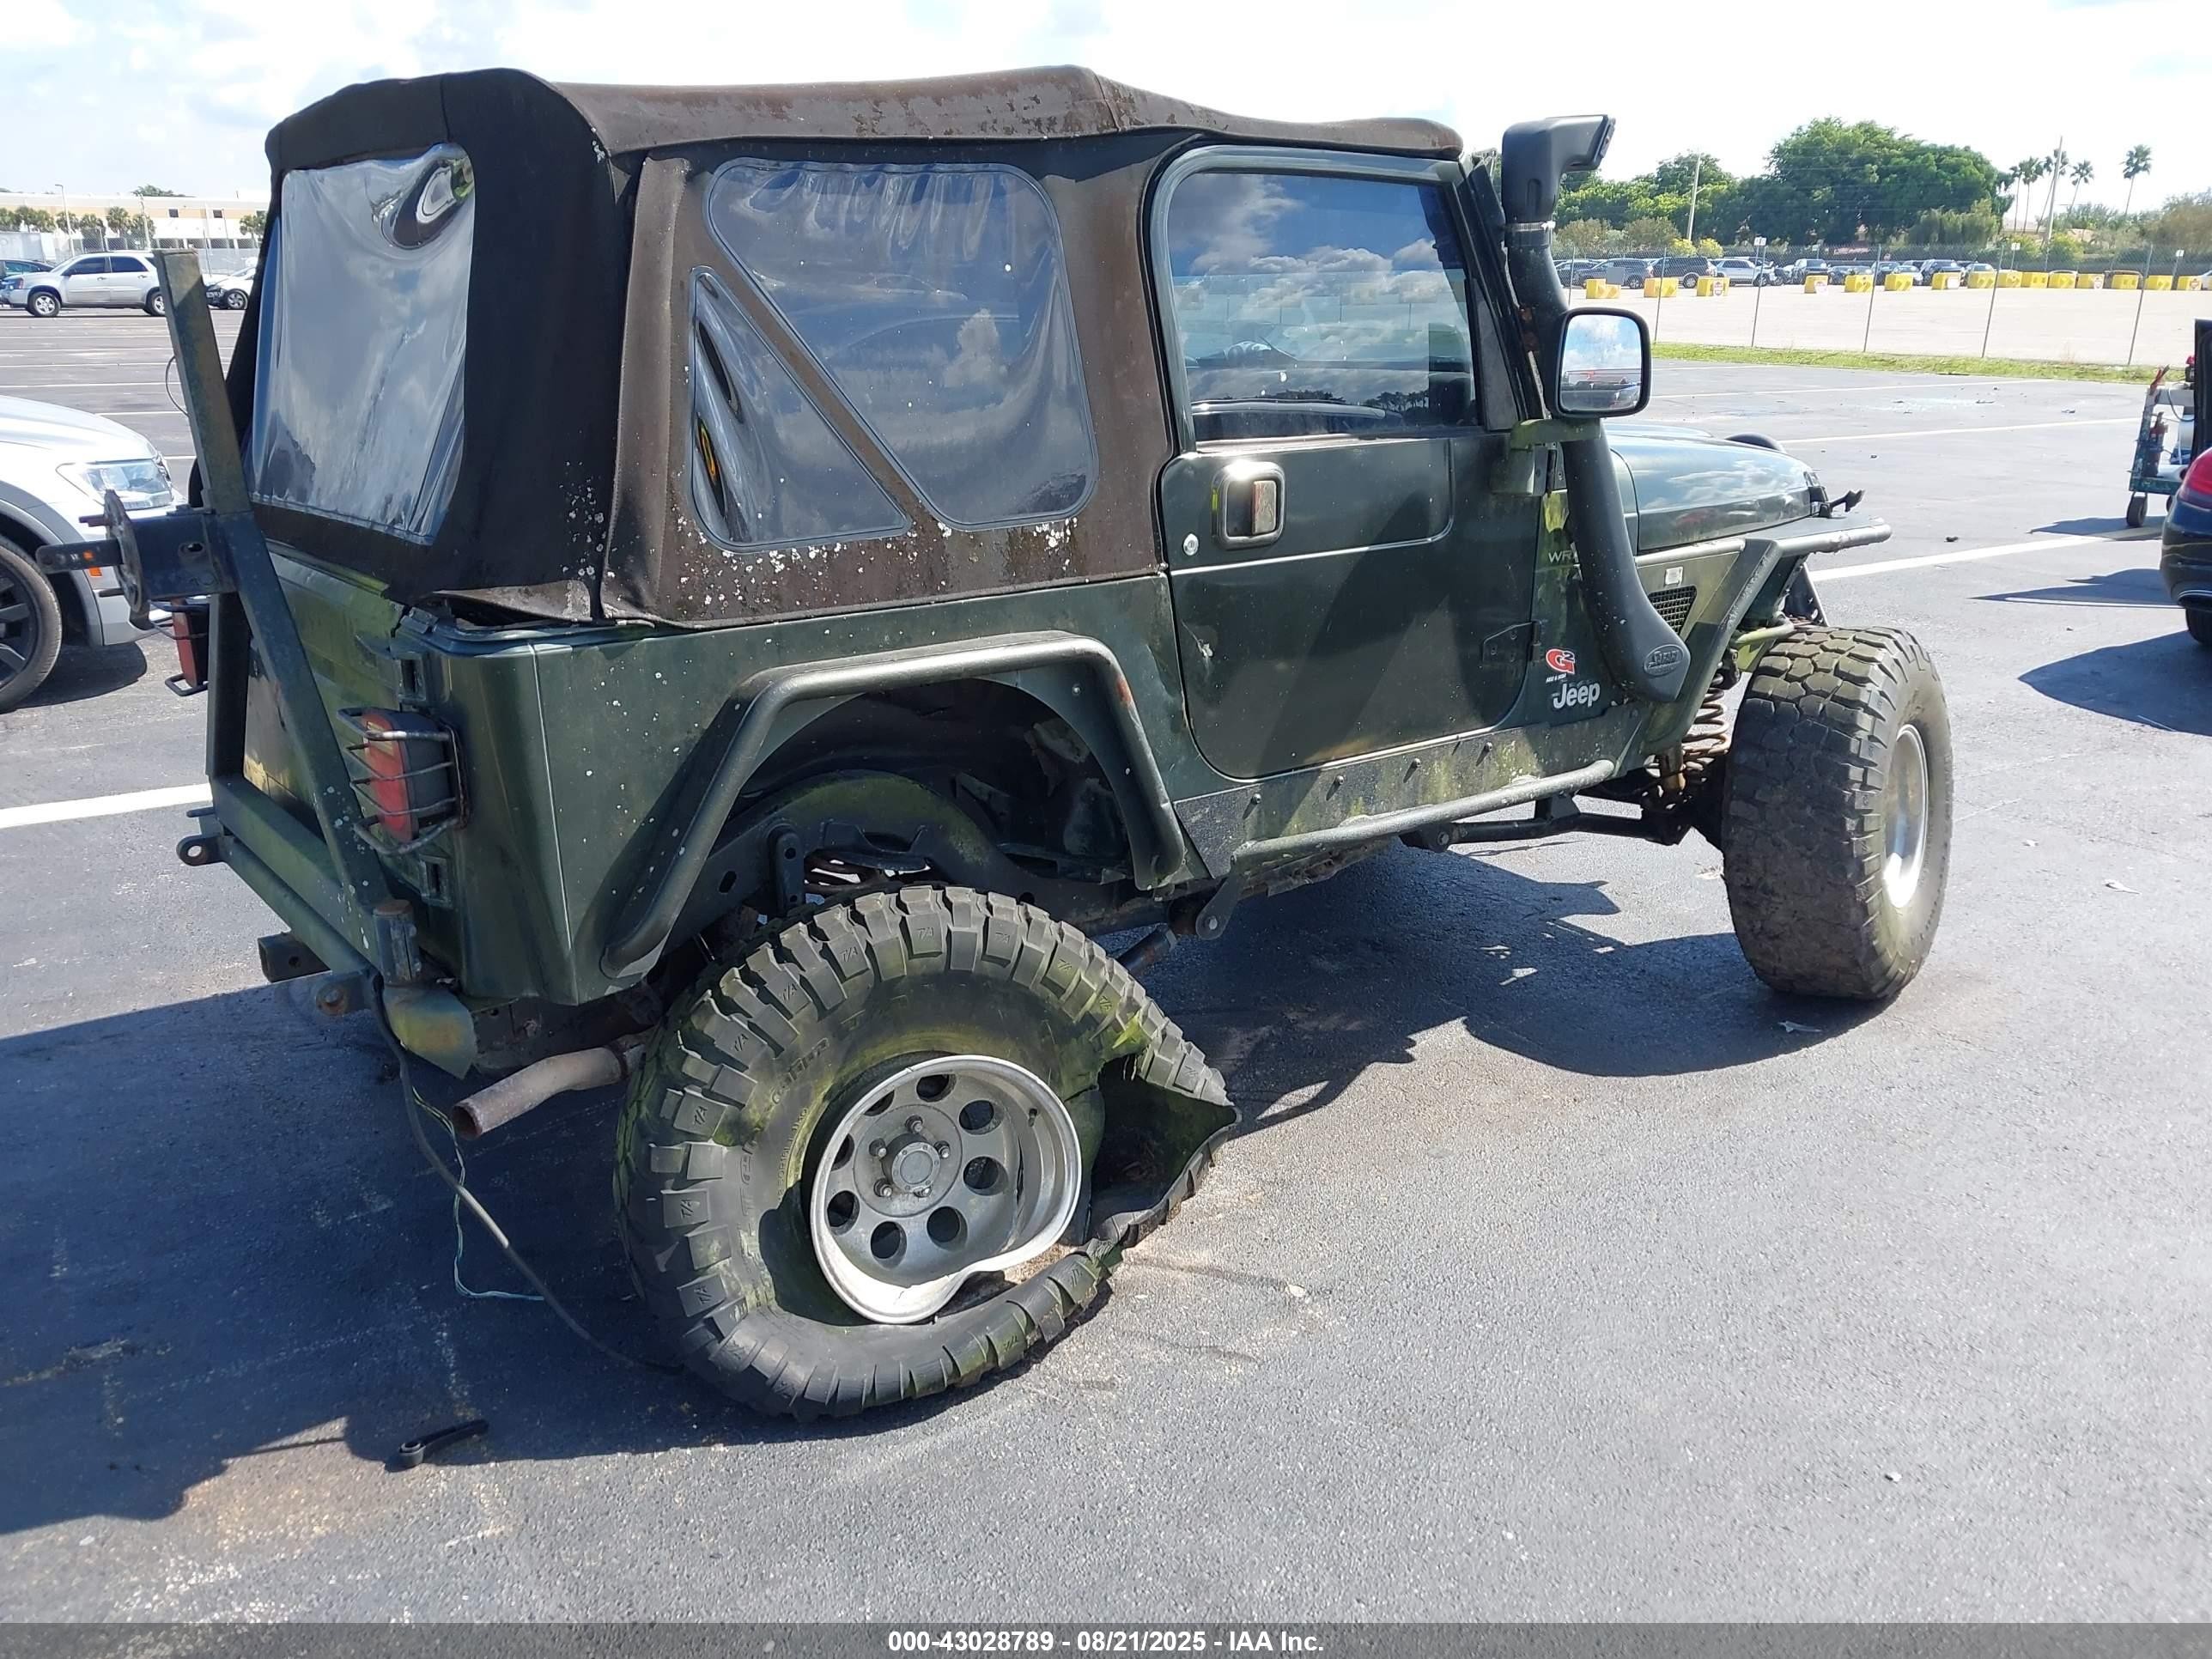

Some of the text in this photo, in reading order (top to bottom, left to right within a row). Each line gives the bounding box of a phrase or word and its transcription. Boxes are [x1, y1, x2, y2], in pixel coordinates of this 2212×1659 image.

[1552, 681, 1601, 709] Jeep
[916, 927, 934, 941] T/A
[839, 945, 859, 963] T/A
[781, 983, 798, 1000] T/A
[734, 1033, 749, 1052] T/A
[692, 1106, 708, 1125] T/A
[680, 1199, 693, 1218] T/A
[693, 1285, 712, 1305] T/A
